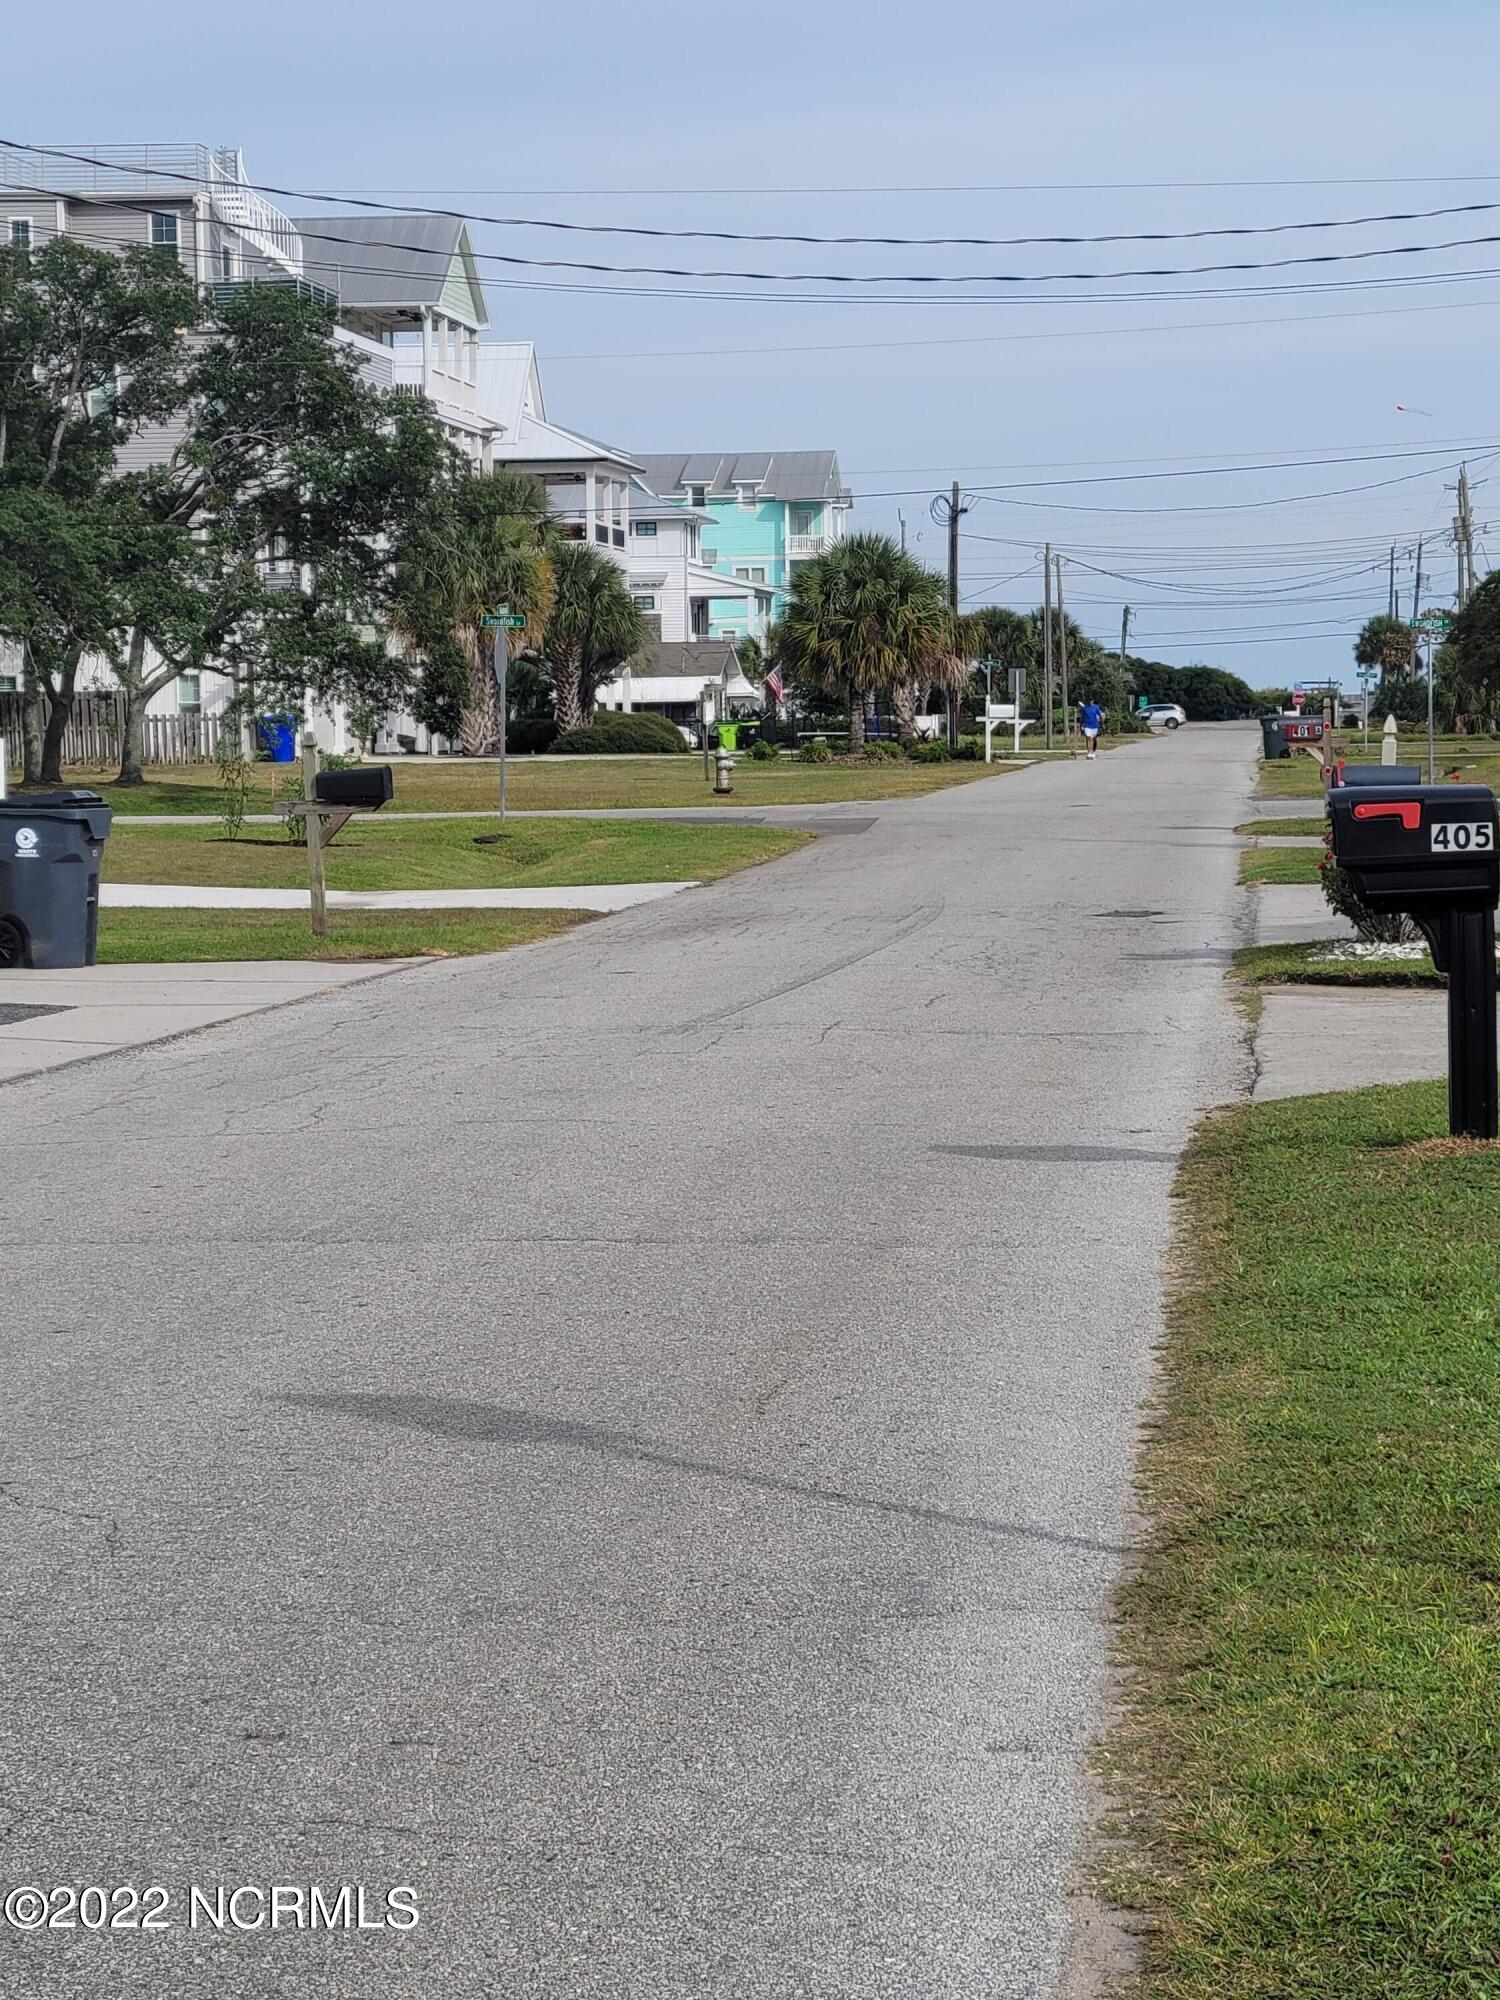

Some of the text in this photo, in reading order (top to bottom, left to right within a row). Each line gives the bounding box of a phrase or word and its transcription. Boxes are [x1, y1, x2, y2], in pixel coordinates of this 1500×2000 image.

[485, 616, 514, 625] Swordfish
[1411, 619, 1443, 627] SWORDFISH
[1433, 824, 1490, 849] 405
